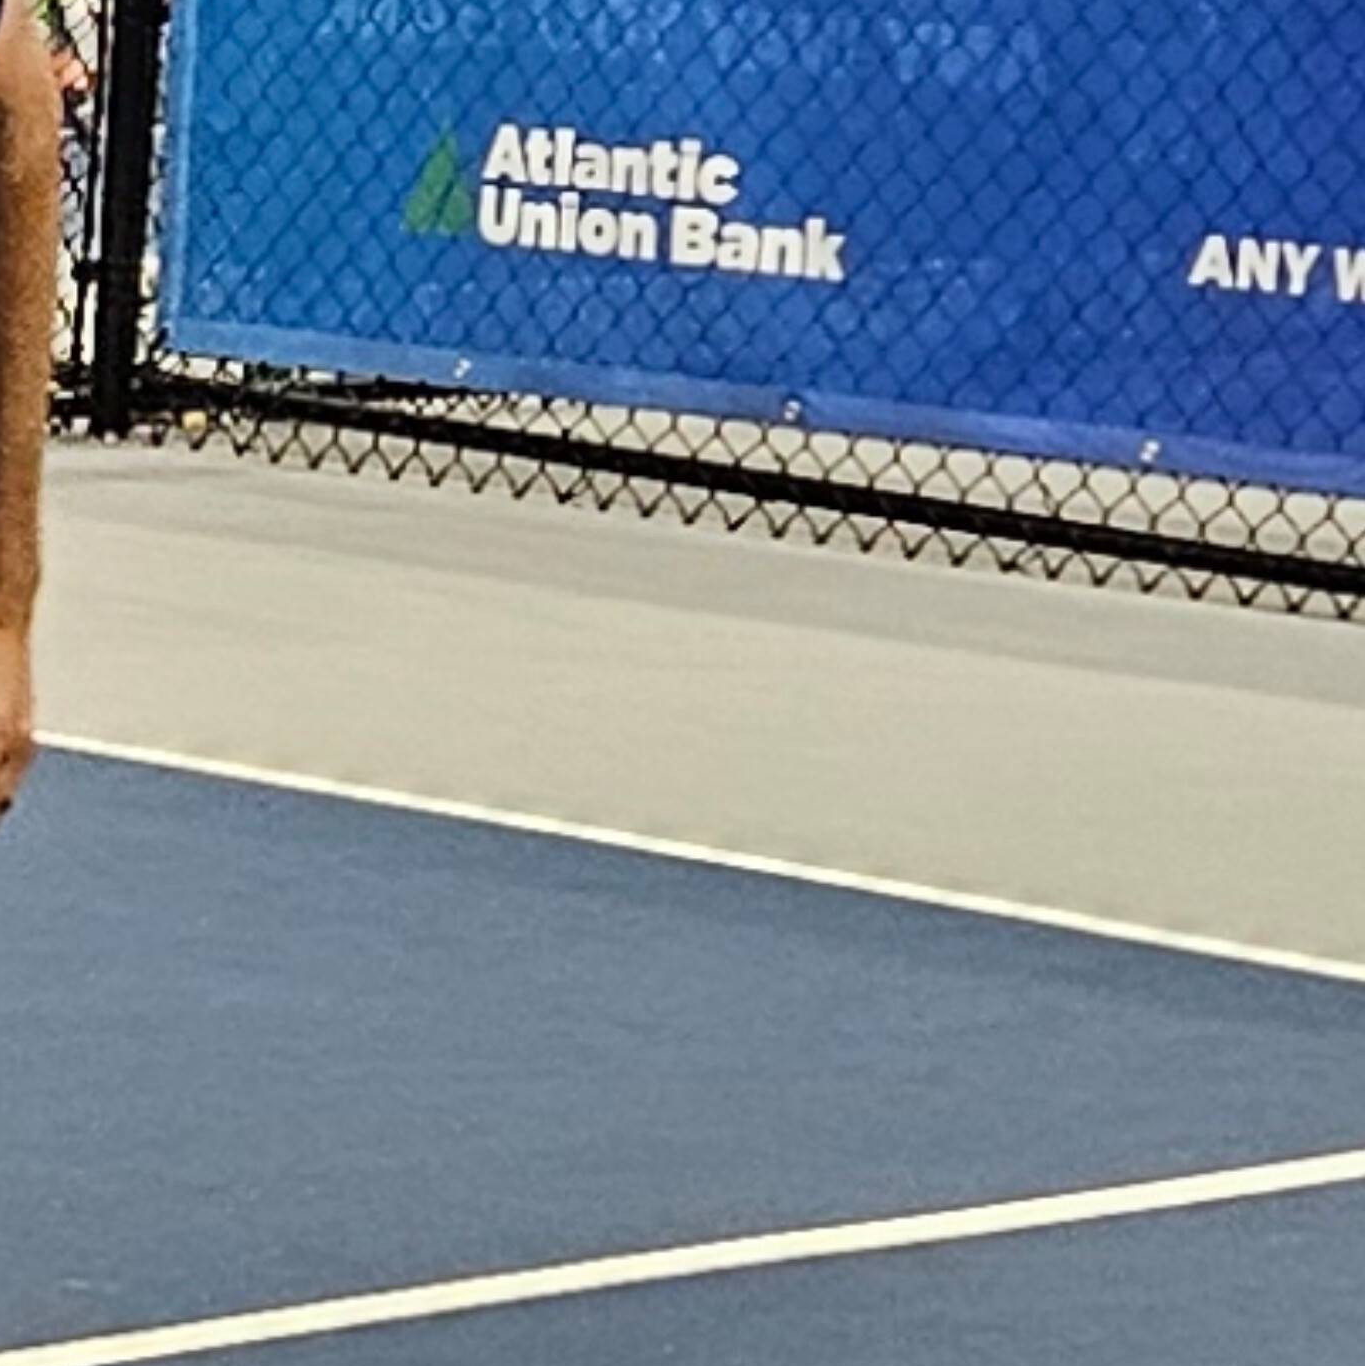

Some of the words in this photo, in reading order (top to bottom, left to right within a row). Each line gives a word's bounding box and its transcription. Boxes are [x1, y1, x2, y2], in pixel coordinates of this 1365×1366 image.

[481, 123, 740, 205] Atlantic
[477, 184, 658, 262] Union
[671, 206, 846, 283] Bank
[1187, 234, 1322, 298] ANY
